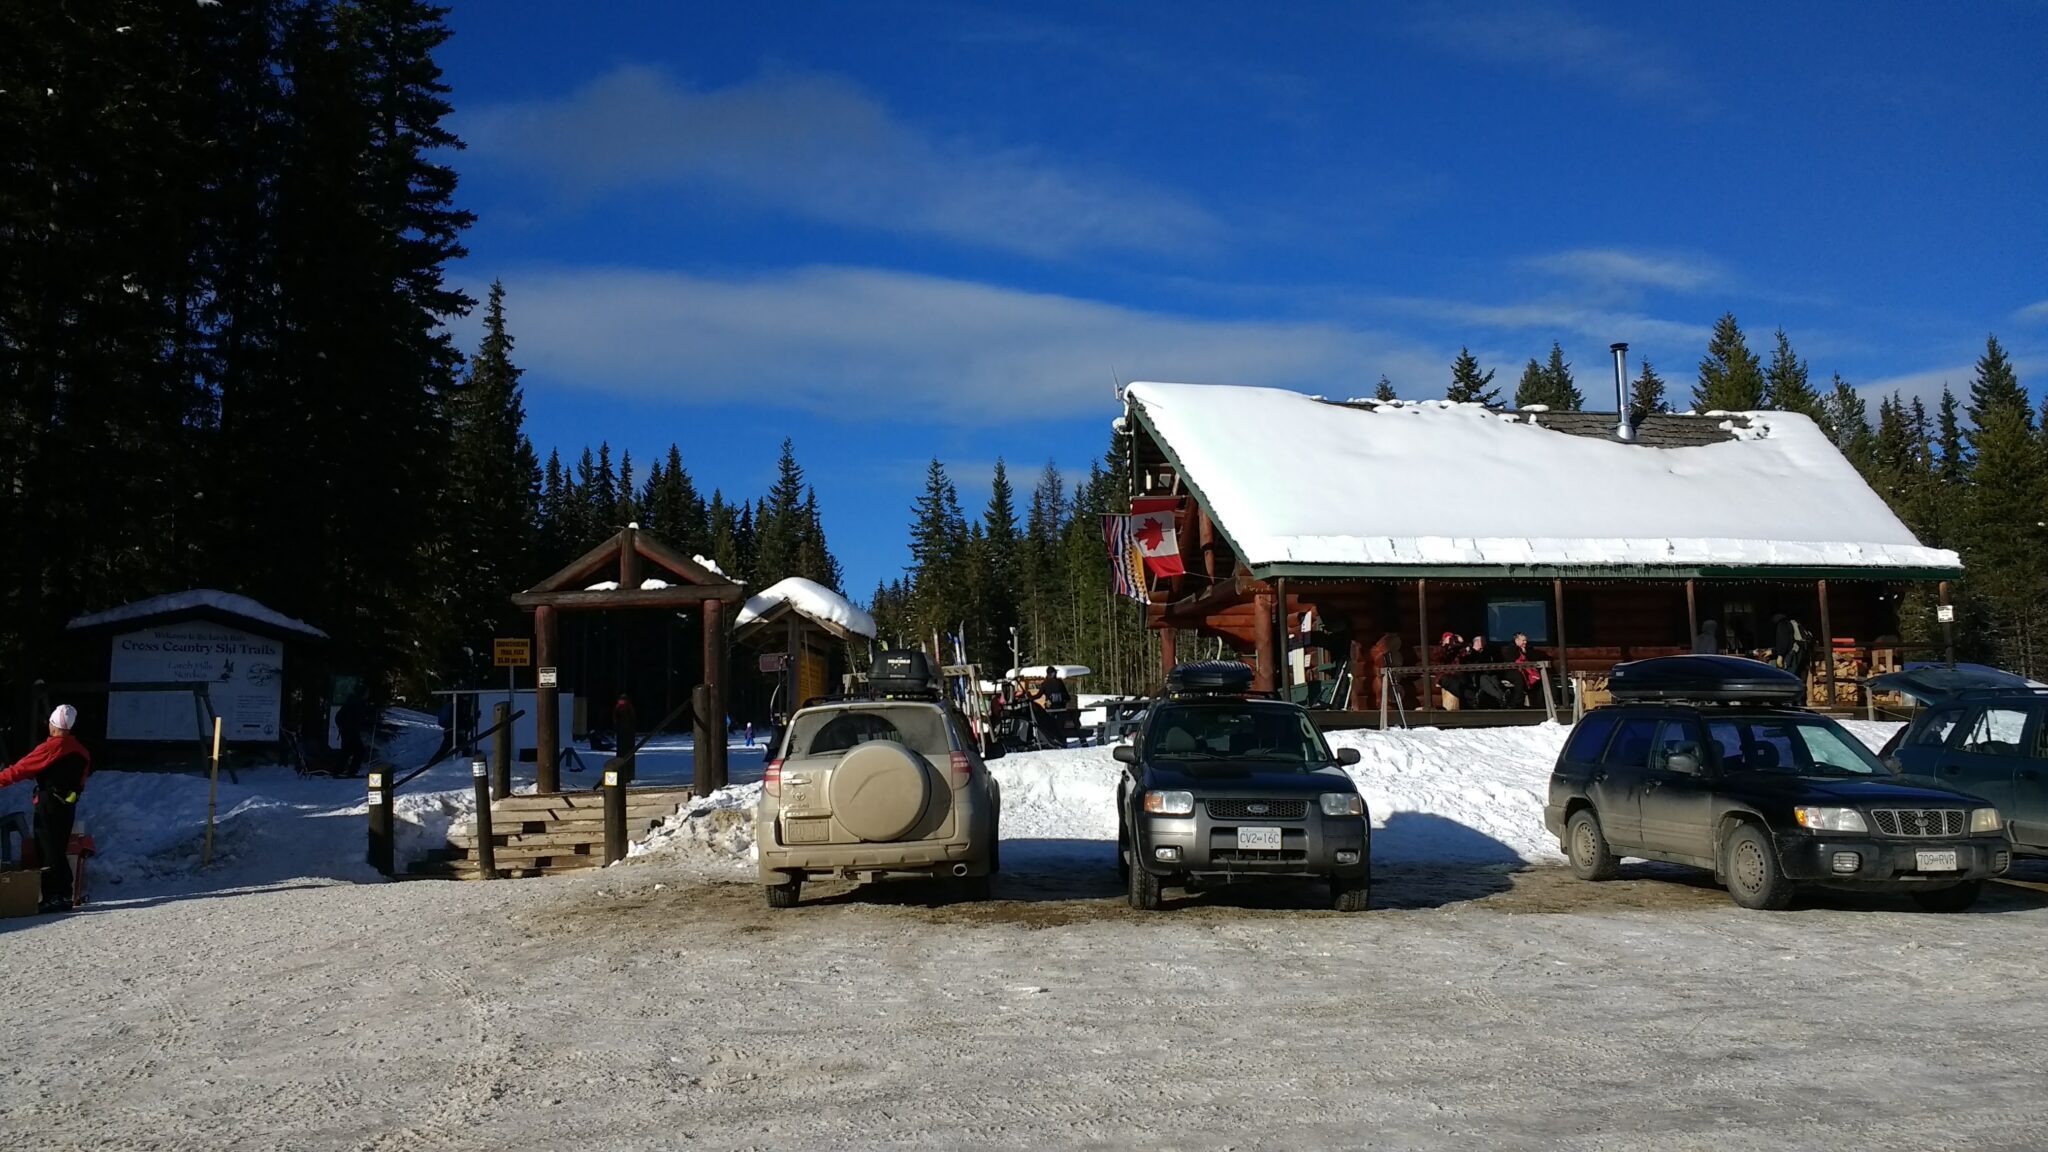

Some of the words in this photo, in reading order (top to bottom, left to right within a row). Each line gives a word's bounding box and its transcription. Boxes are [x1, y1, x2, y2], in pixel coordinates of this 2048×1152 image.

[122, 639, 160, 652] Cross
[162, 641, 211, 655] Country
[215, 643, 237, 655] Ski
[240, 644, 276, 656] Trails
